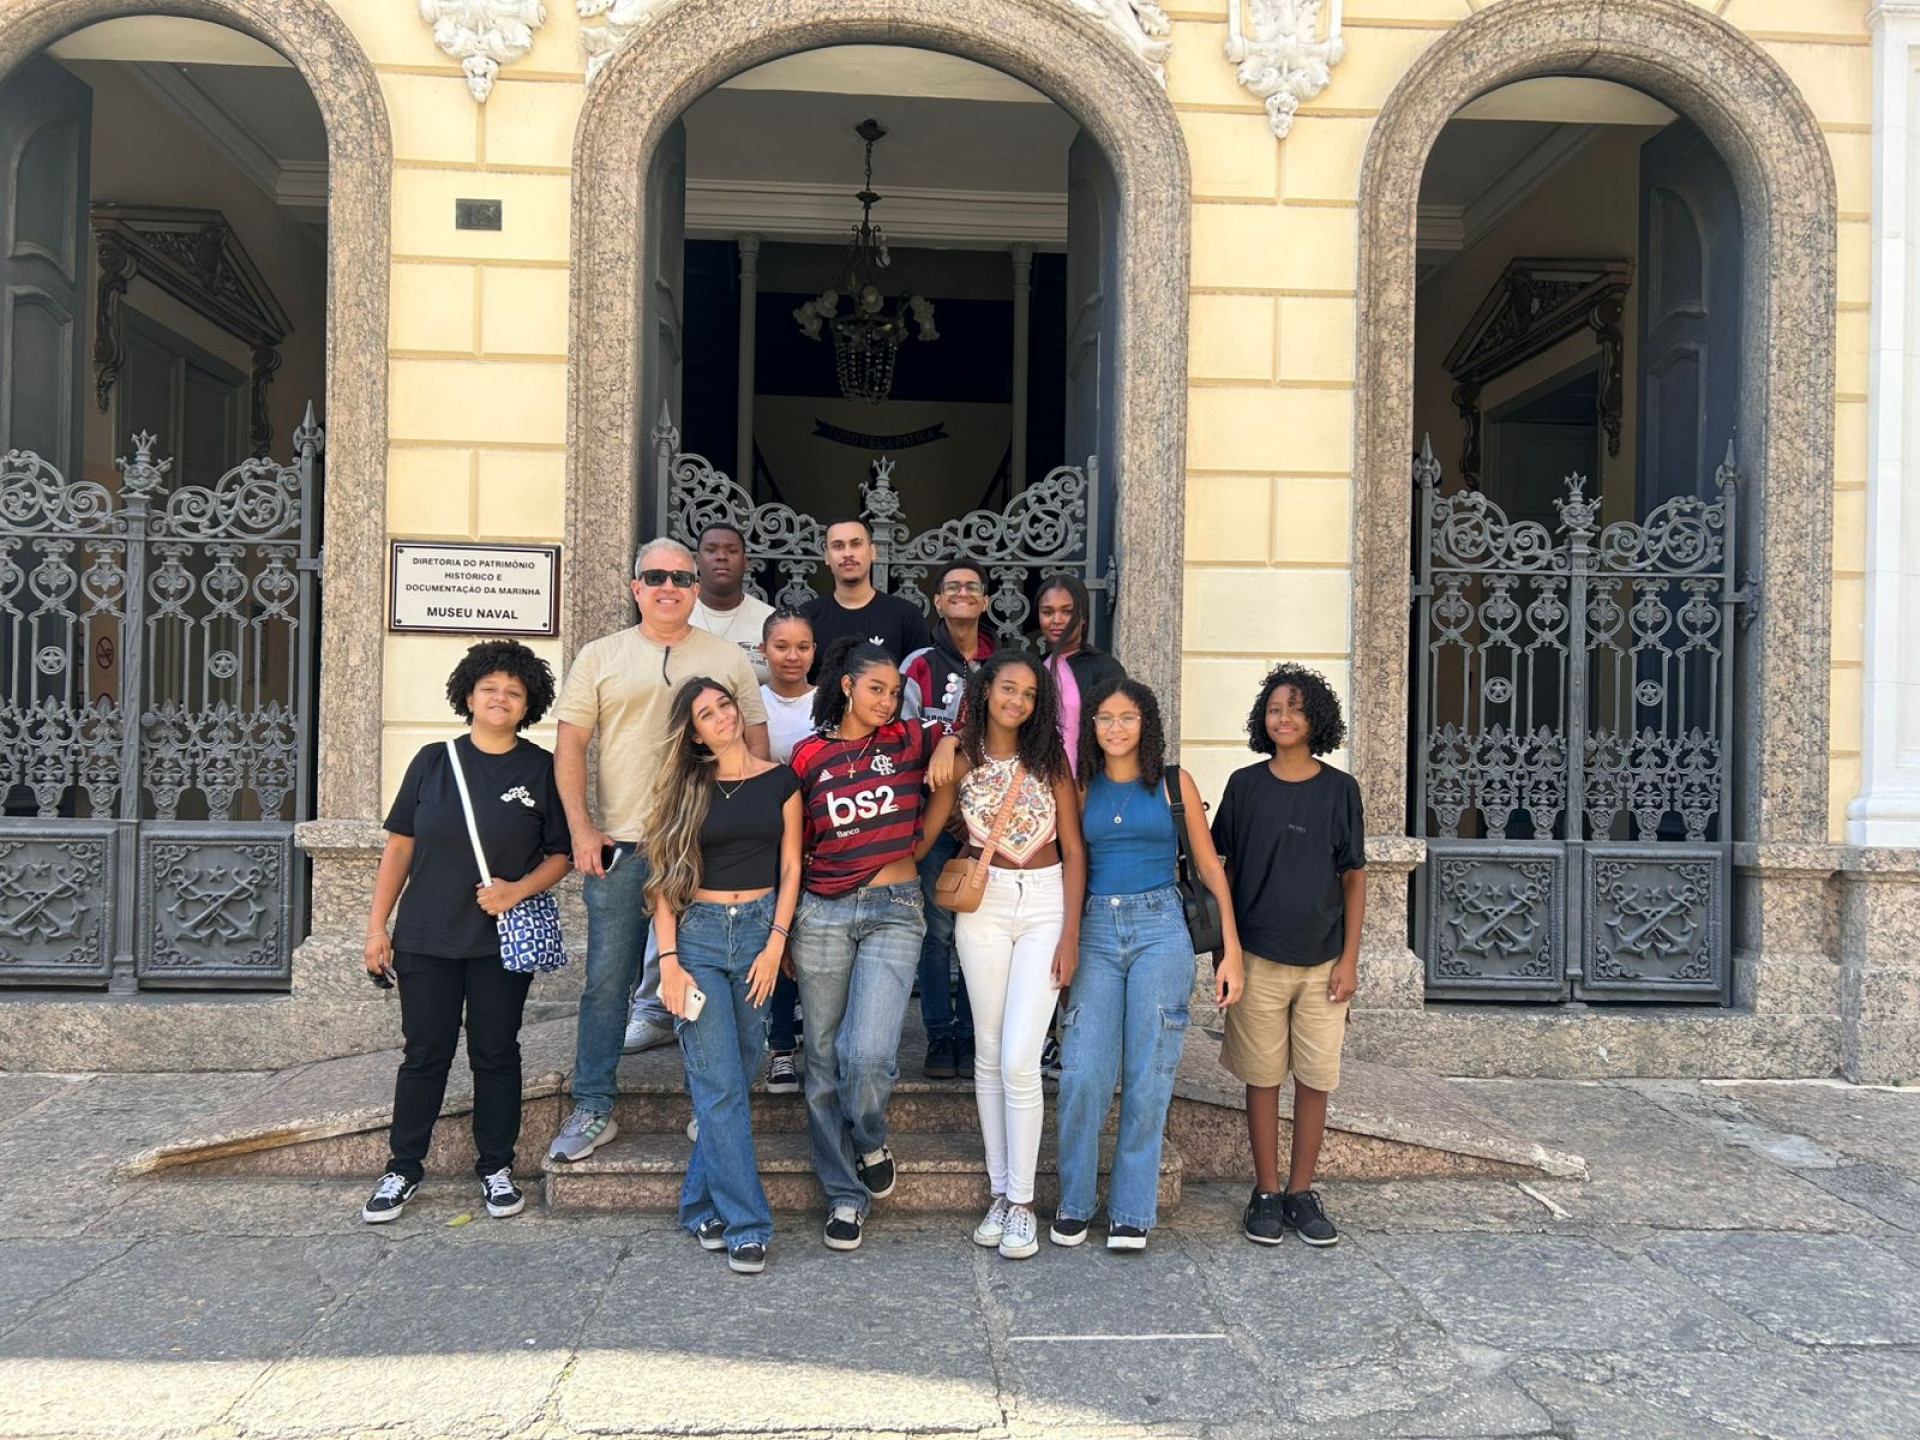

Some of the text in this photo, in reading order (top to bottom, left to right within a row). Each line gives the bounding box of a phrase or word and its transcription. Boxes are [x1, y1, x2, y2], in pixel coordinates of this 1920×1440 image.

[412, 557, 535, 569] DIRETORIA DO PATRIMÔNIO
[445, 571, 503, 581] HISTÓRICO E
[405, 583, 541, 595] DOCUMENTAÇÃO DA MARINHA
[426, 606, 519, 620] MUSEU NAVAL
[826, 785, 899, 828] bs2
[836, 827, 860, 839] Banco
